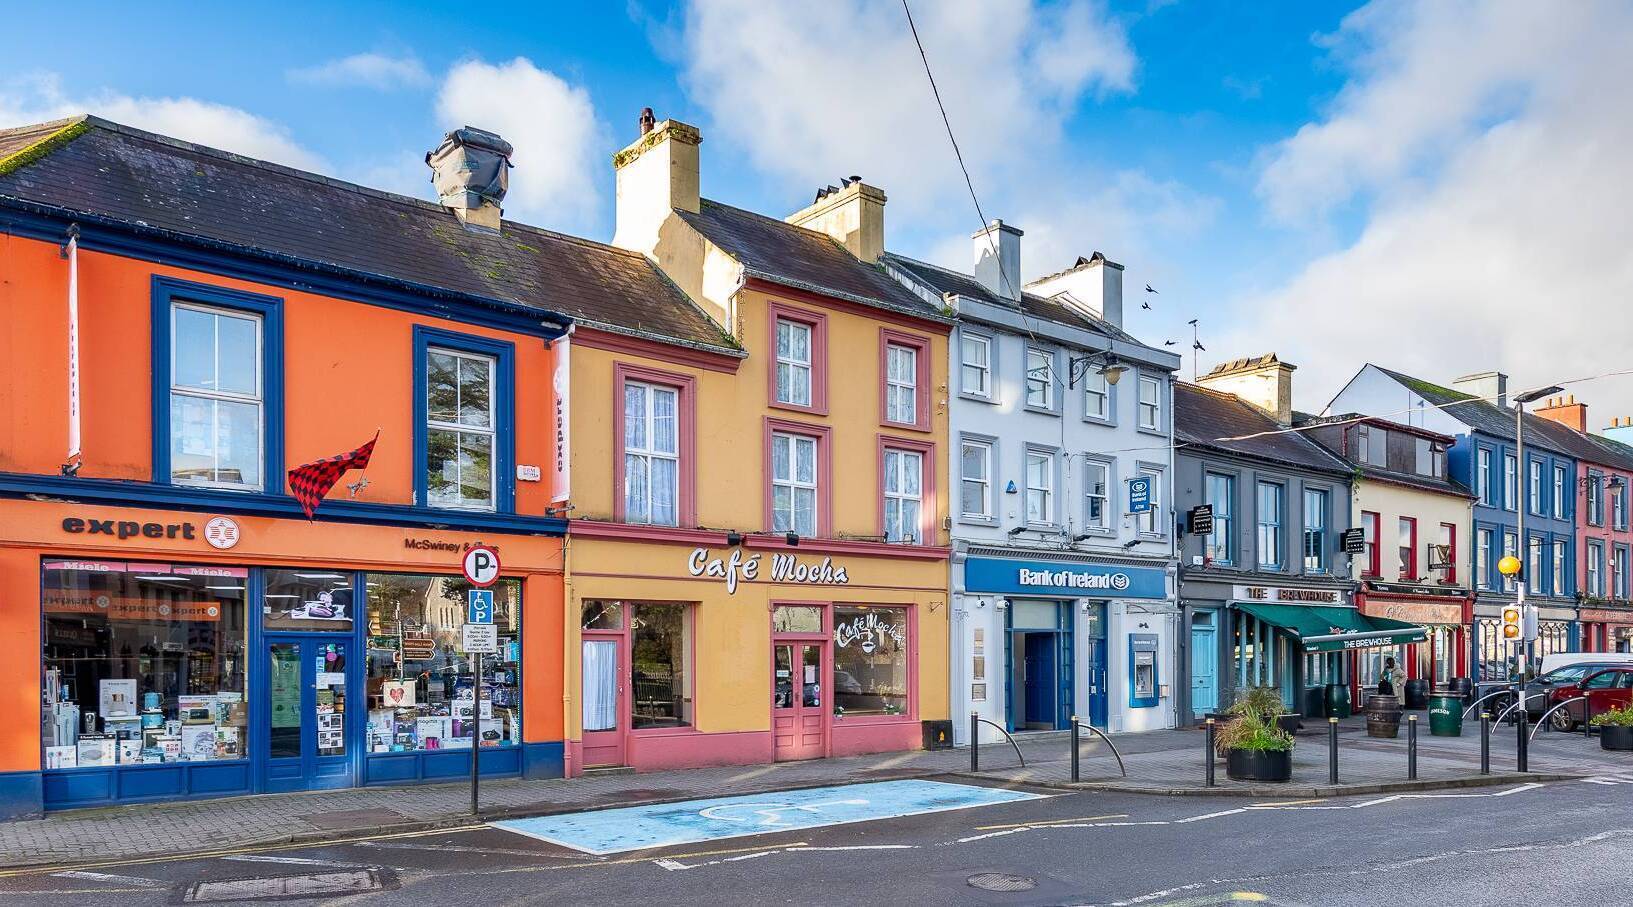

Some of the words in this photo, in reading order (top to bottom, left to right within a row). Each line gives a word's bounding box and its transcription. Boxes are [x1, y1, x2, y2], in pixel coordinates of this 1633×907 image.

[62, 517, 195, 540] expert
[404, 539, 460, 553] McSwiney
[63, 562, 109, 572] Miele
[190, 567, 232, 577] Miele
[475, 553, 490, 578] P
[688, 547, 762, 594] Café
[771, 553, 850, 583] Mocha
[1019, 568, 1053, 586] Bank
[1053, 571, 1068, 586] of
[1069, 572, 1110, 589] Ireland
[1247, 587, 1268, 600] THE
[1278, 588, 1338, 603] BREWHOUSE
[475, 611, 486, 623] P
[836, 617, 865, 648] Café
[866, 613, 904, 645] Mocha
[1343, 640, 1356, 648] THE
[1355, 637, 1392, 648] BREWHOUSE
